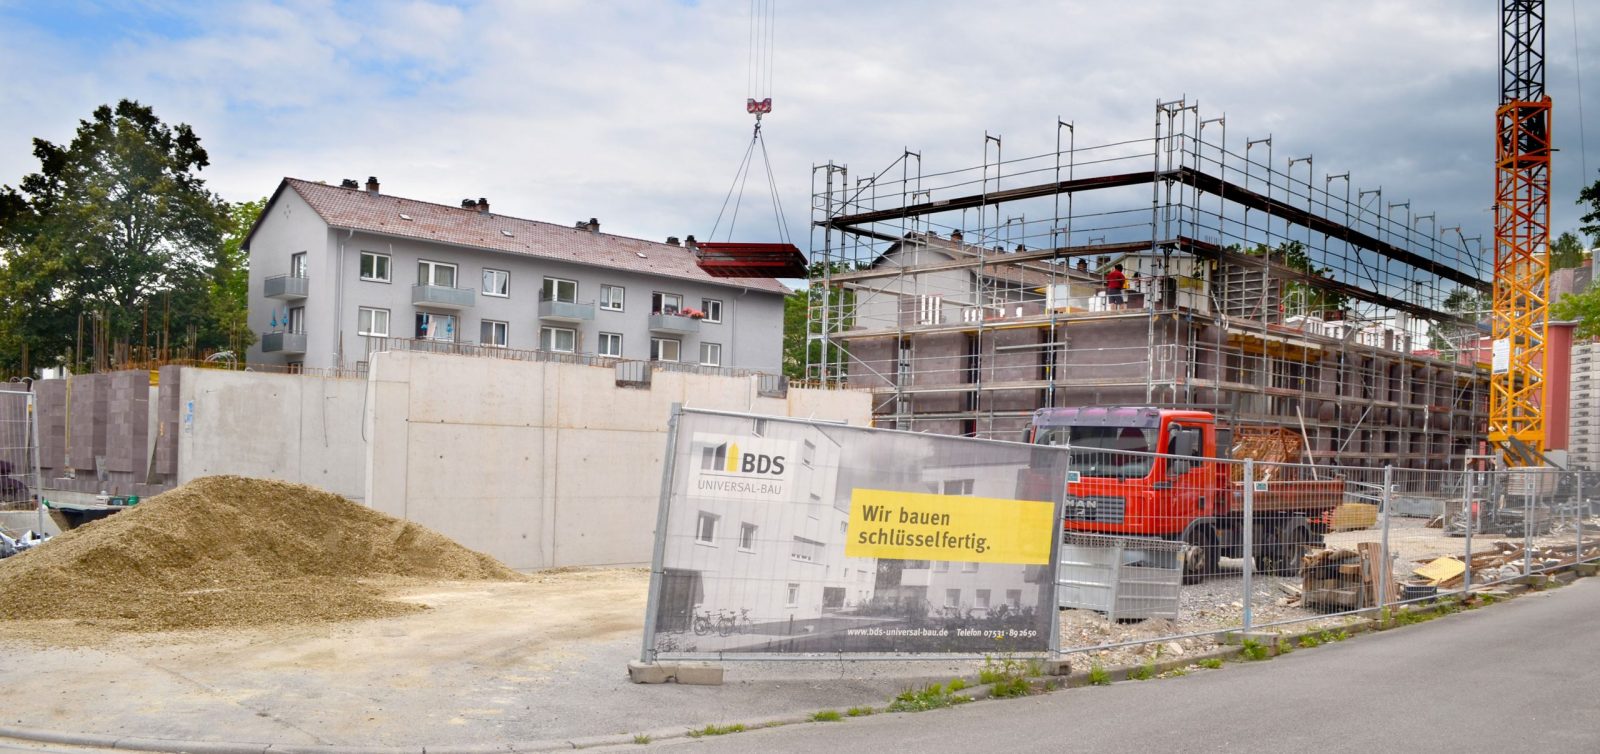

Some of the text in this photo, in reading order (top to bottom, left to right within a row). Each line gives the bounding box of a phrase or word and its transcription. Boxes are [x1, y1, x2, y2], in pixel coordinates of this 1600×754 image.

[741, 452, 785, 475] BDS
[697, 479, 782, 495] UNIVERSAL-BAU
[1064, 499, 1097, 508] MAN
[862, 504, 950, 526] Wir bauen
[858, 527, 991, 554] schlüsselfertig.
[847, 627, 949, 637] www.bds-universal-bau.de
[956, 628, 982, 637] Telefon
